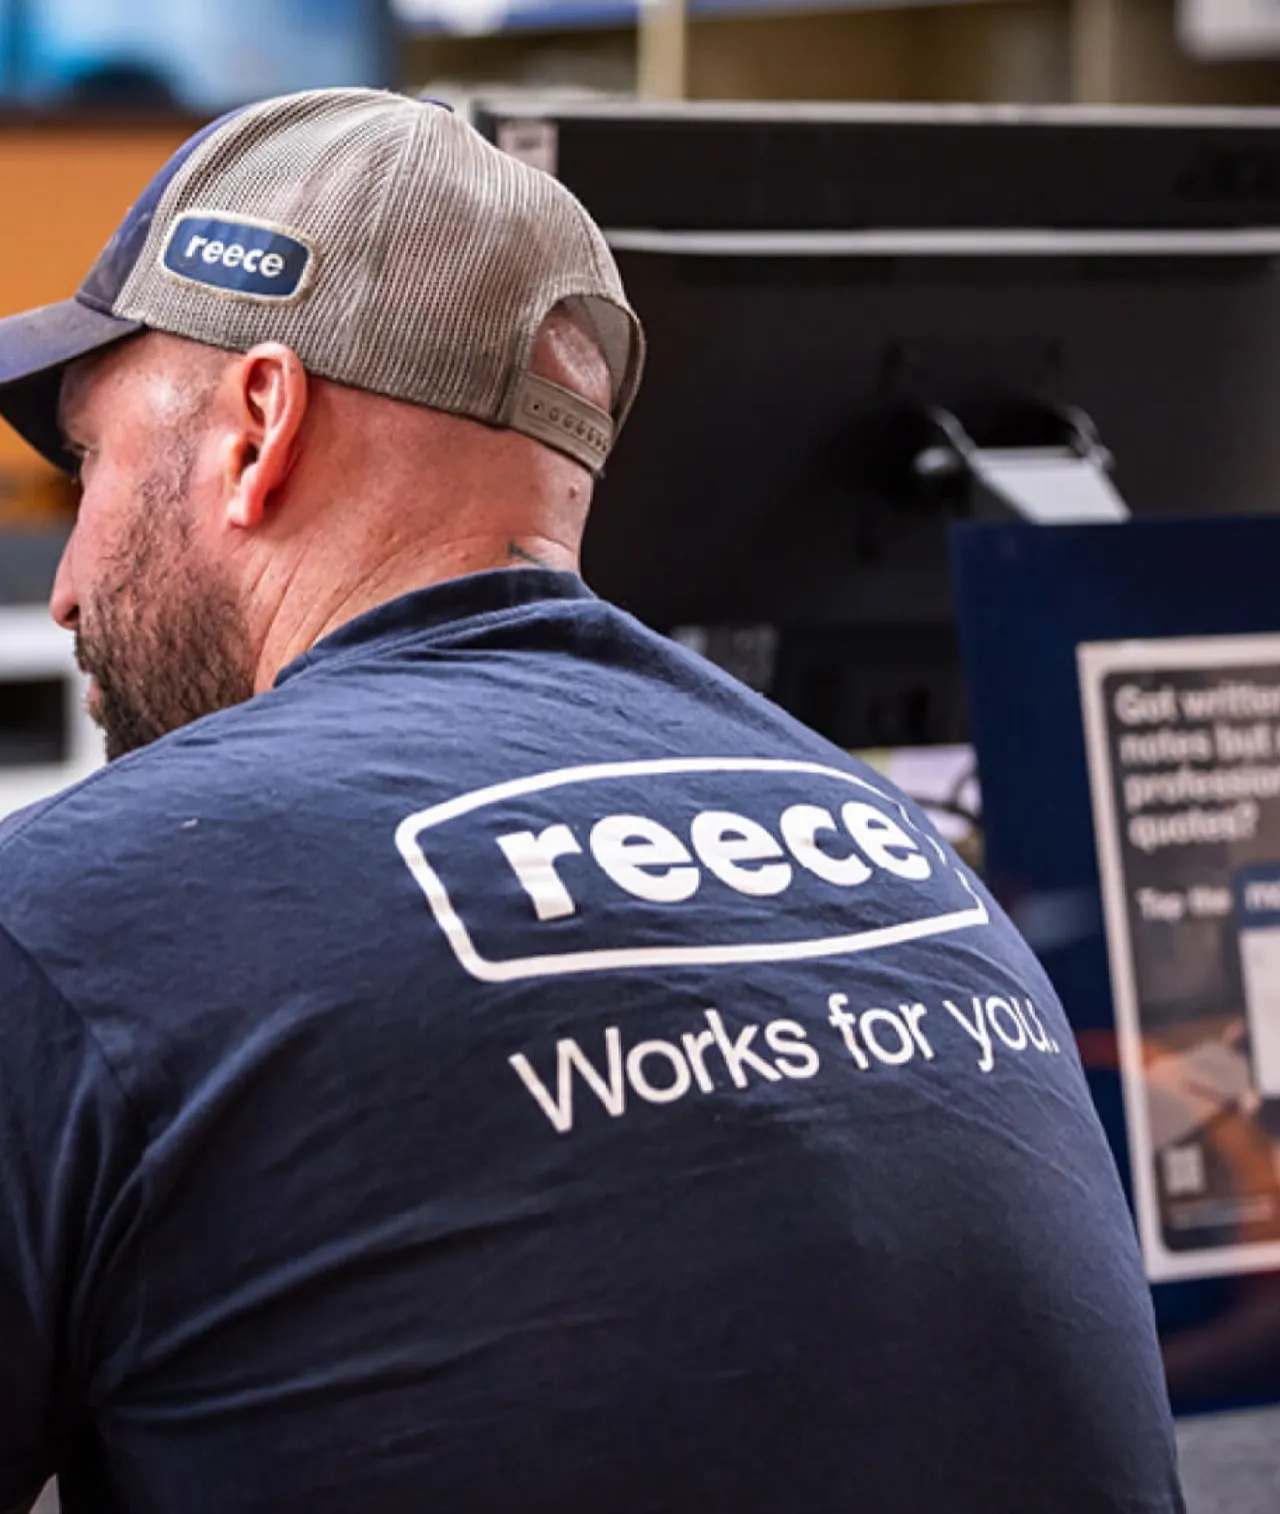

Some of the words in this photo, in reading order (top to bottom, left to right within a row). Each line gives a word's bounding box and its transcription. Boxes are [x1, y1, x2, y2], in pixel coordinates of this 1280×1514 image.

[185, 235, 285, 278] reece
[496, 802, 931, 920] reece
[509, 1009, 820, 1132] Works
[827, 993, 935, 1070] for
[942, 996, 1061, 1072] you.
